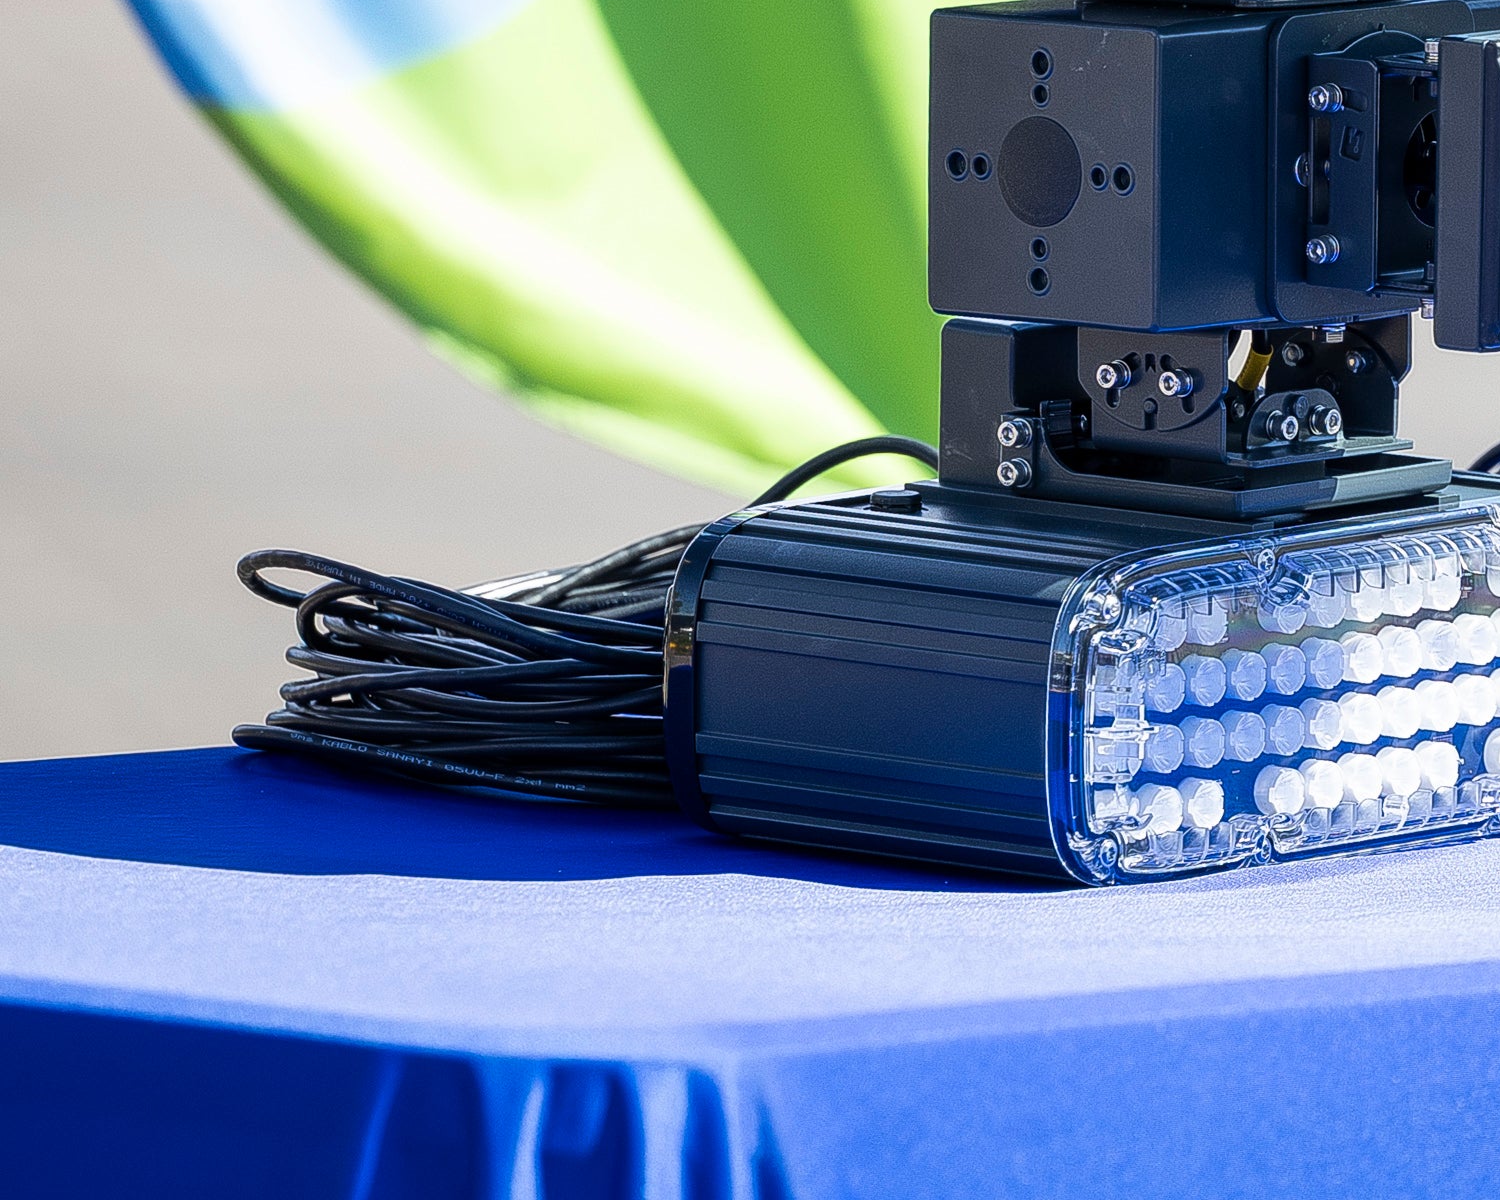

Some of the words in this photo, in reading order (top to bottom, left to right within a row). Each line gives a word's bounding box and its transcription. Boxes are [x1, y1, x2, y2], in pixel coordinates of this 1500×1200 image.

[349, 574, 362, 585] IN
[369, 580, 396, 596] MADE
[321, 738, 368, 753] KABLO
[376, 748, 433, 767] SANAYI
